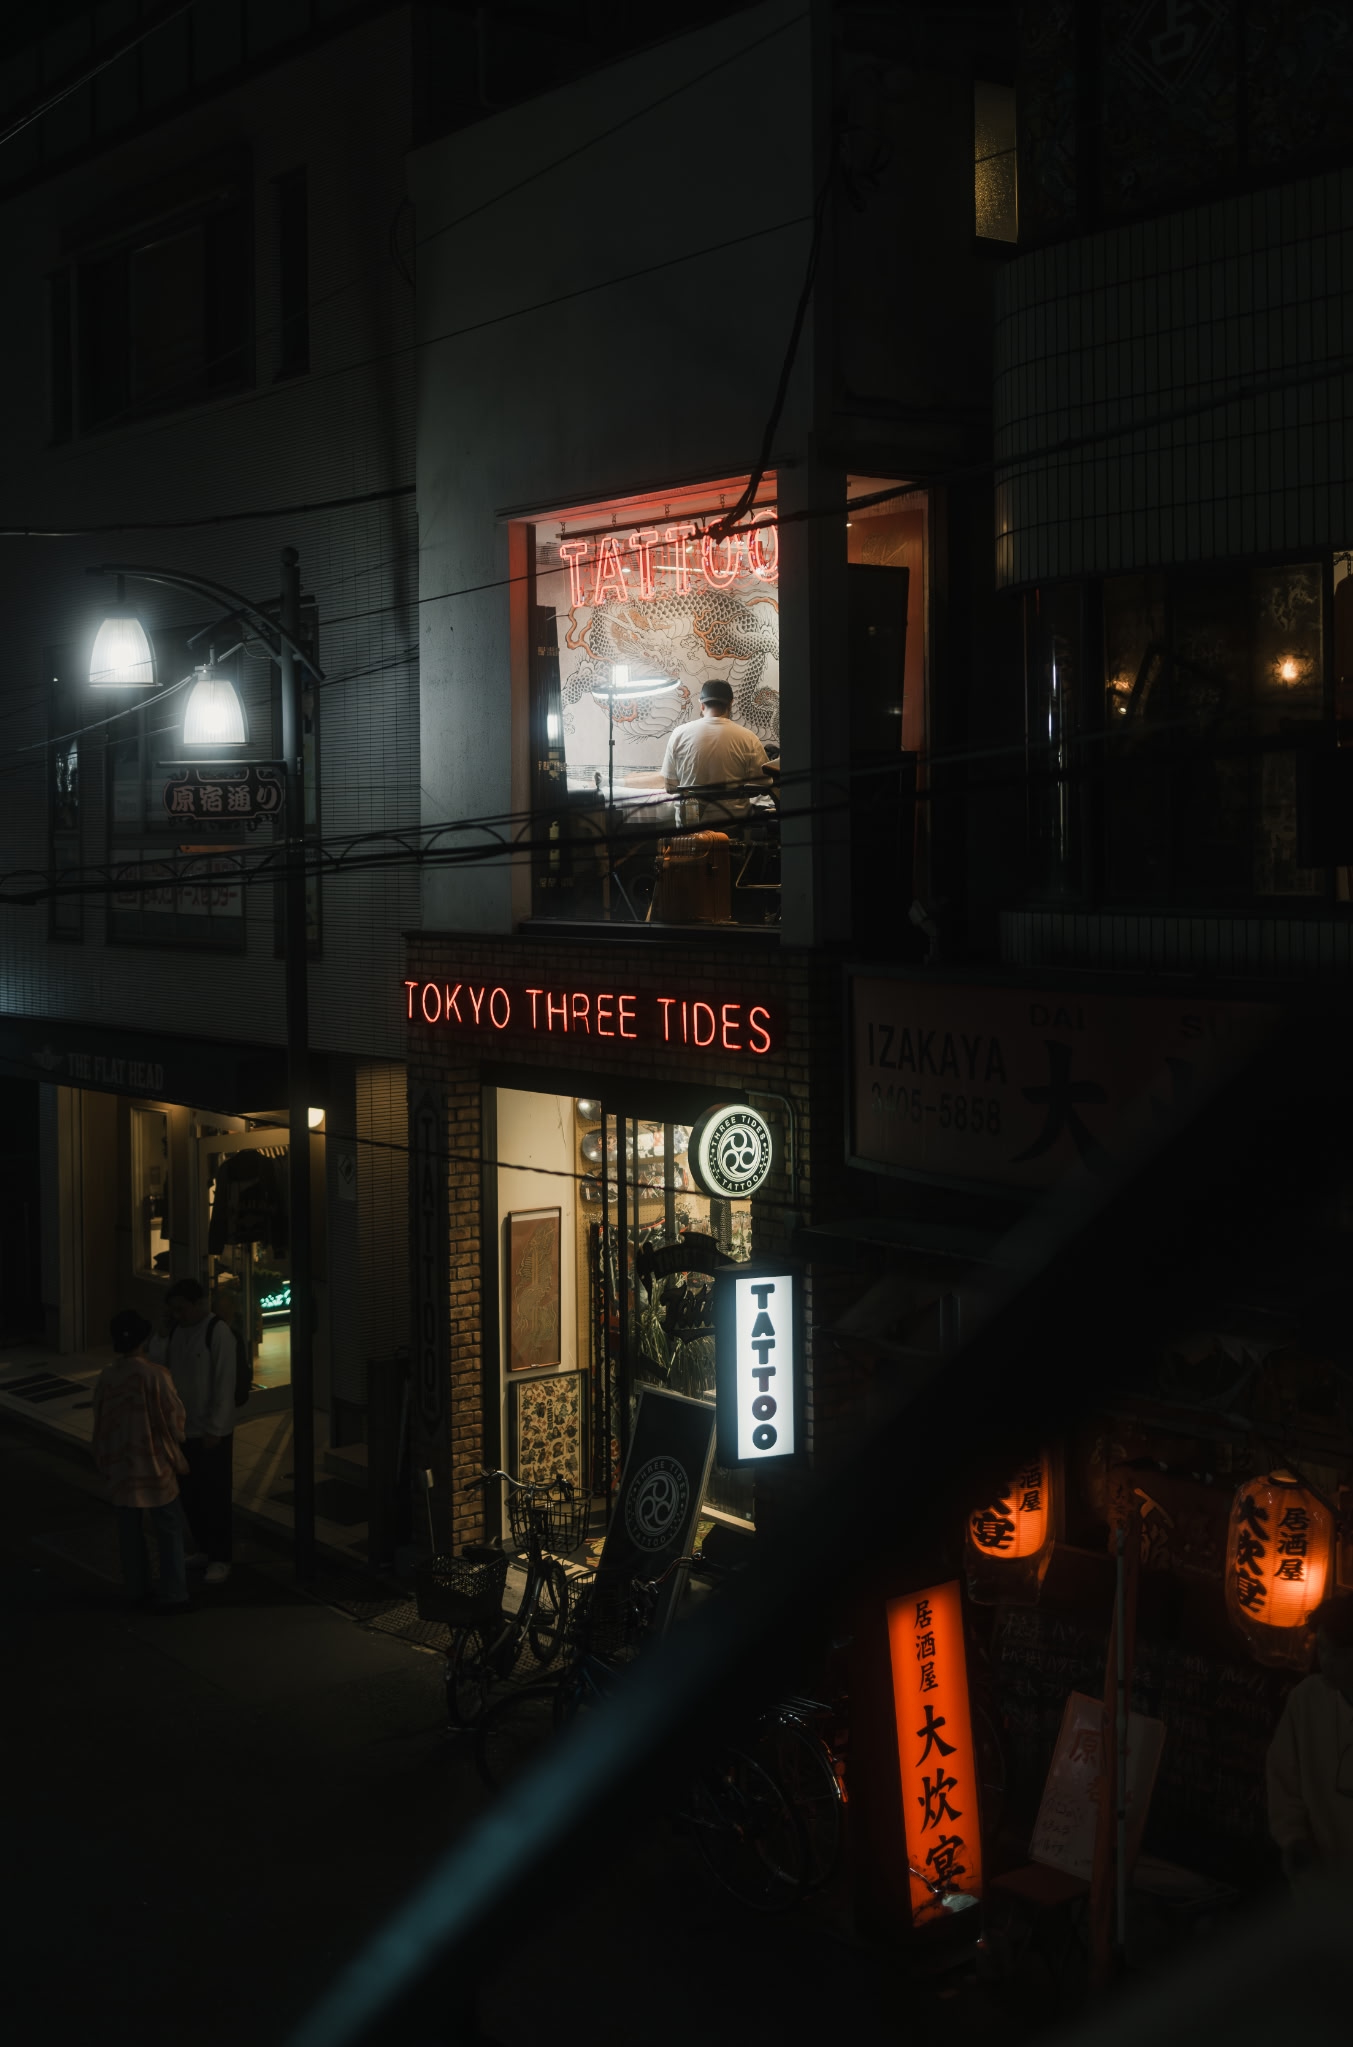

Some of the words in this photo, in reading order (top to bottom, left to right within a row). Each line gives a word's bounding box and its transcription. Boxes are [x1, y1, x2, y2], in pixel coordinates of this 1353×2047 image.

[560, 511, 778, 608] TATTOO
[171, 785, 278, 812] 原宿通り
[404, 981, 511, 1029] TOKYO
[525, 988, 638, 1039] THREE
[656, 997, 772, 1055] TIDES
[1029, 1003, 1085, 1031] DAI
[66, 1052, 92, 1080] THE
[95, 1055, 126, 1085] FLAT
[128, 1060, 164, 1091] HEAD
[867, 1022, 1007, 1084] IZAKAYA
[711, 1116, 737, 1147] THREE
[741, 1115, 767, 1141] TIDES
[721, 1174, 759, 1191] TATTOO
[751, 1283, 778, 1451] TATTOO
[635, 1460, 666, 1486] THREE
[669, 1463, 687, 1499] TIDES
[631, 1526, 667, 1547] TATTOO
[1274, 1507, 1311, 1582] 居酒屋
[913, 1600, 939, 1693] 居酒屋
